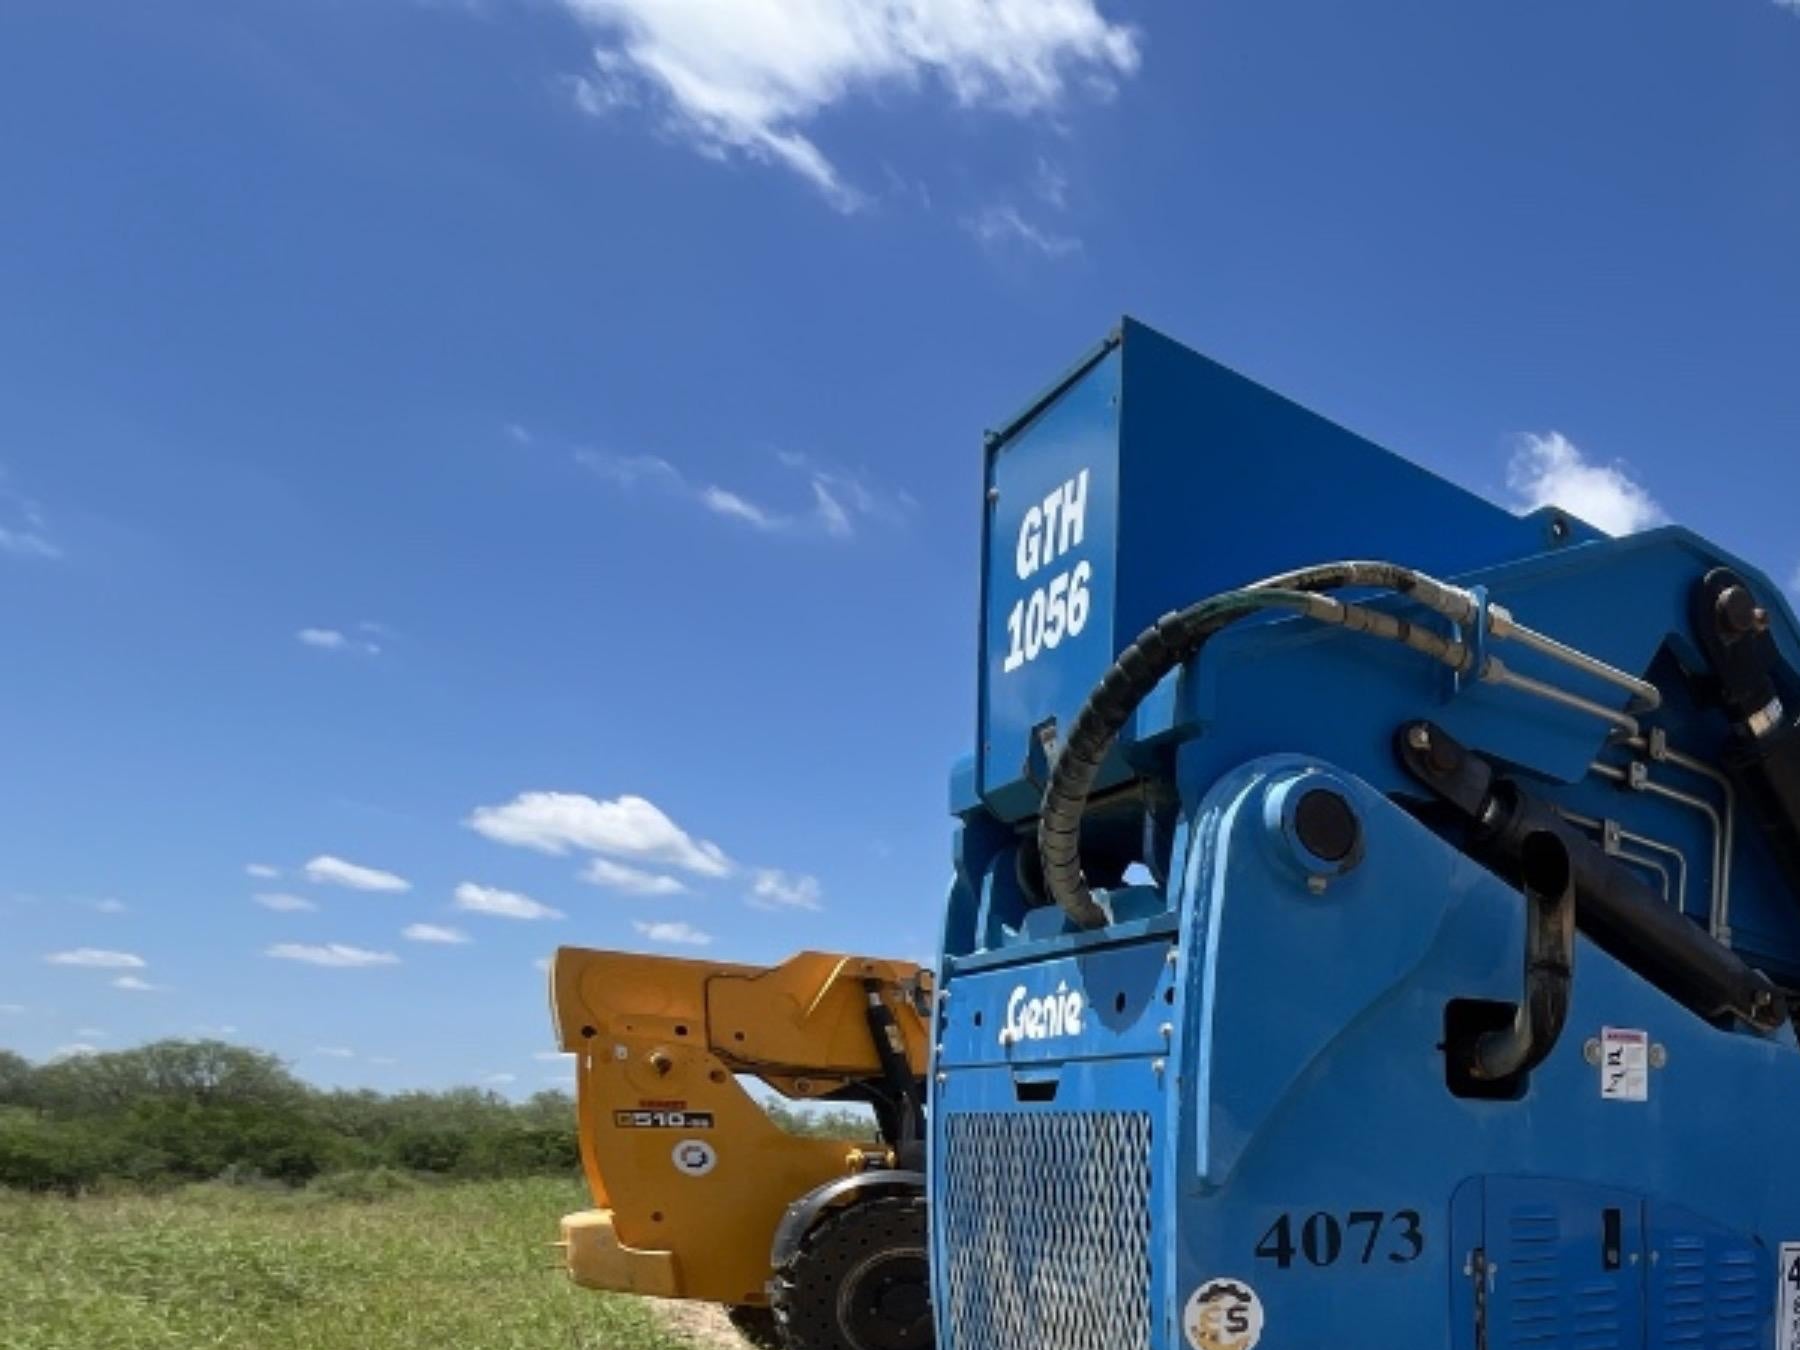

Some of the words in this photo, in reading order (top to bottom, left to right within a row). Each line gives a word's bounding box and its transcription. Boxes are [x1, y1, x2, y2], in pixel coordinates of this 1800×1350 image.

[1015, 467, 1090, 580] GTH
[1003, 560, 1092, 674] 1056
[998, 979, 1082, 1046] Genie
[1254, 1209, 1424, 1269] 4073
